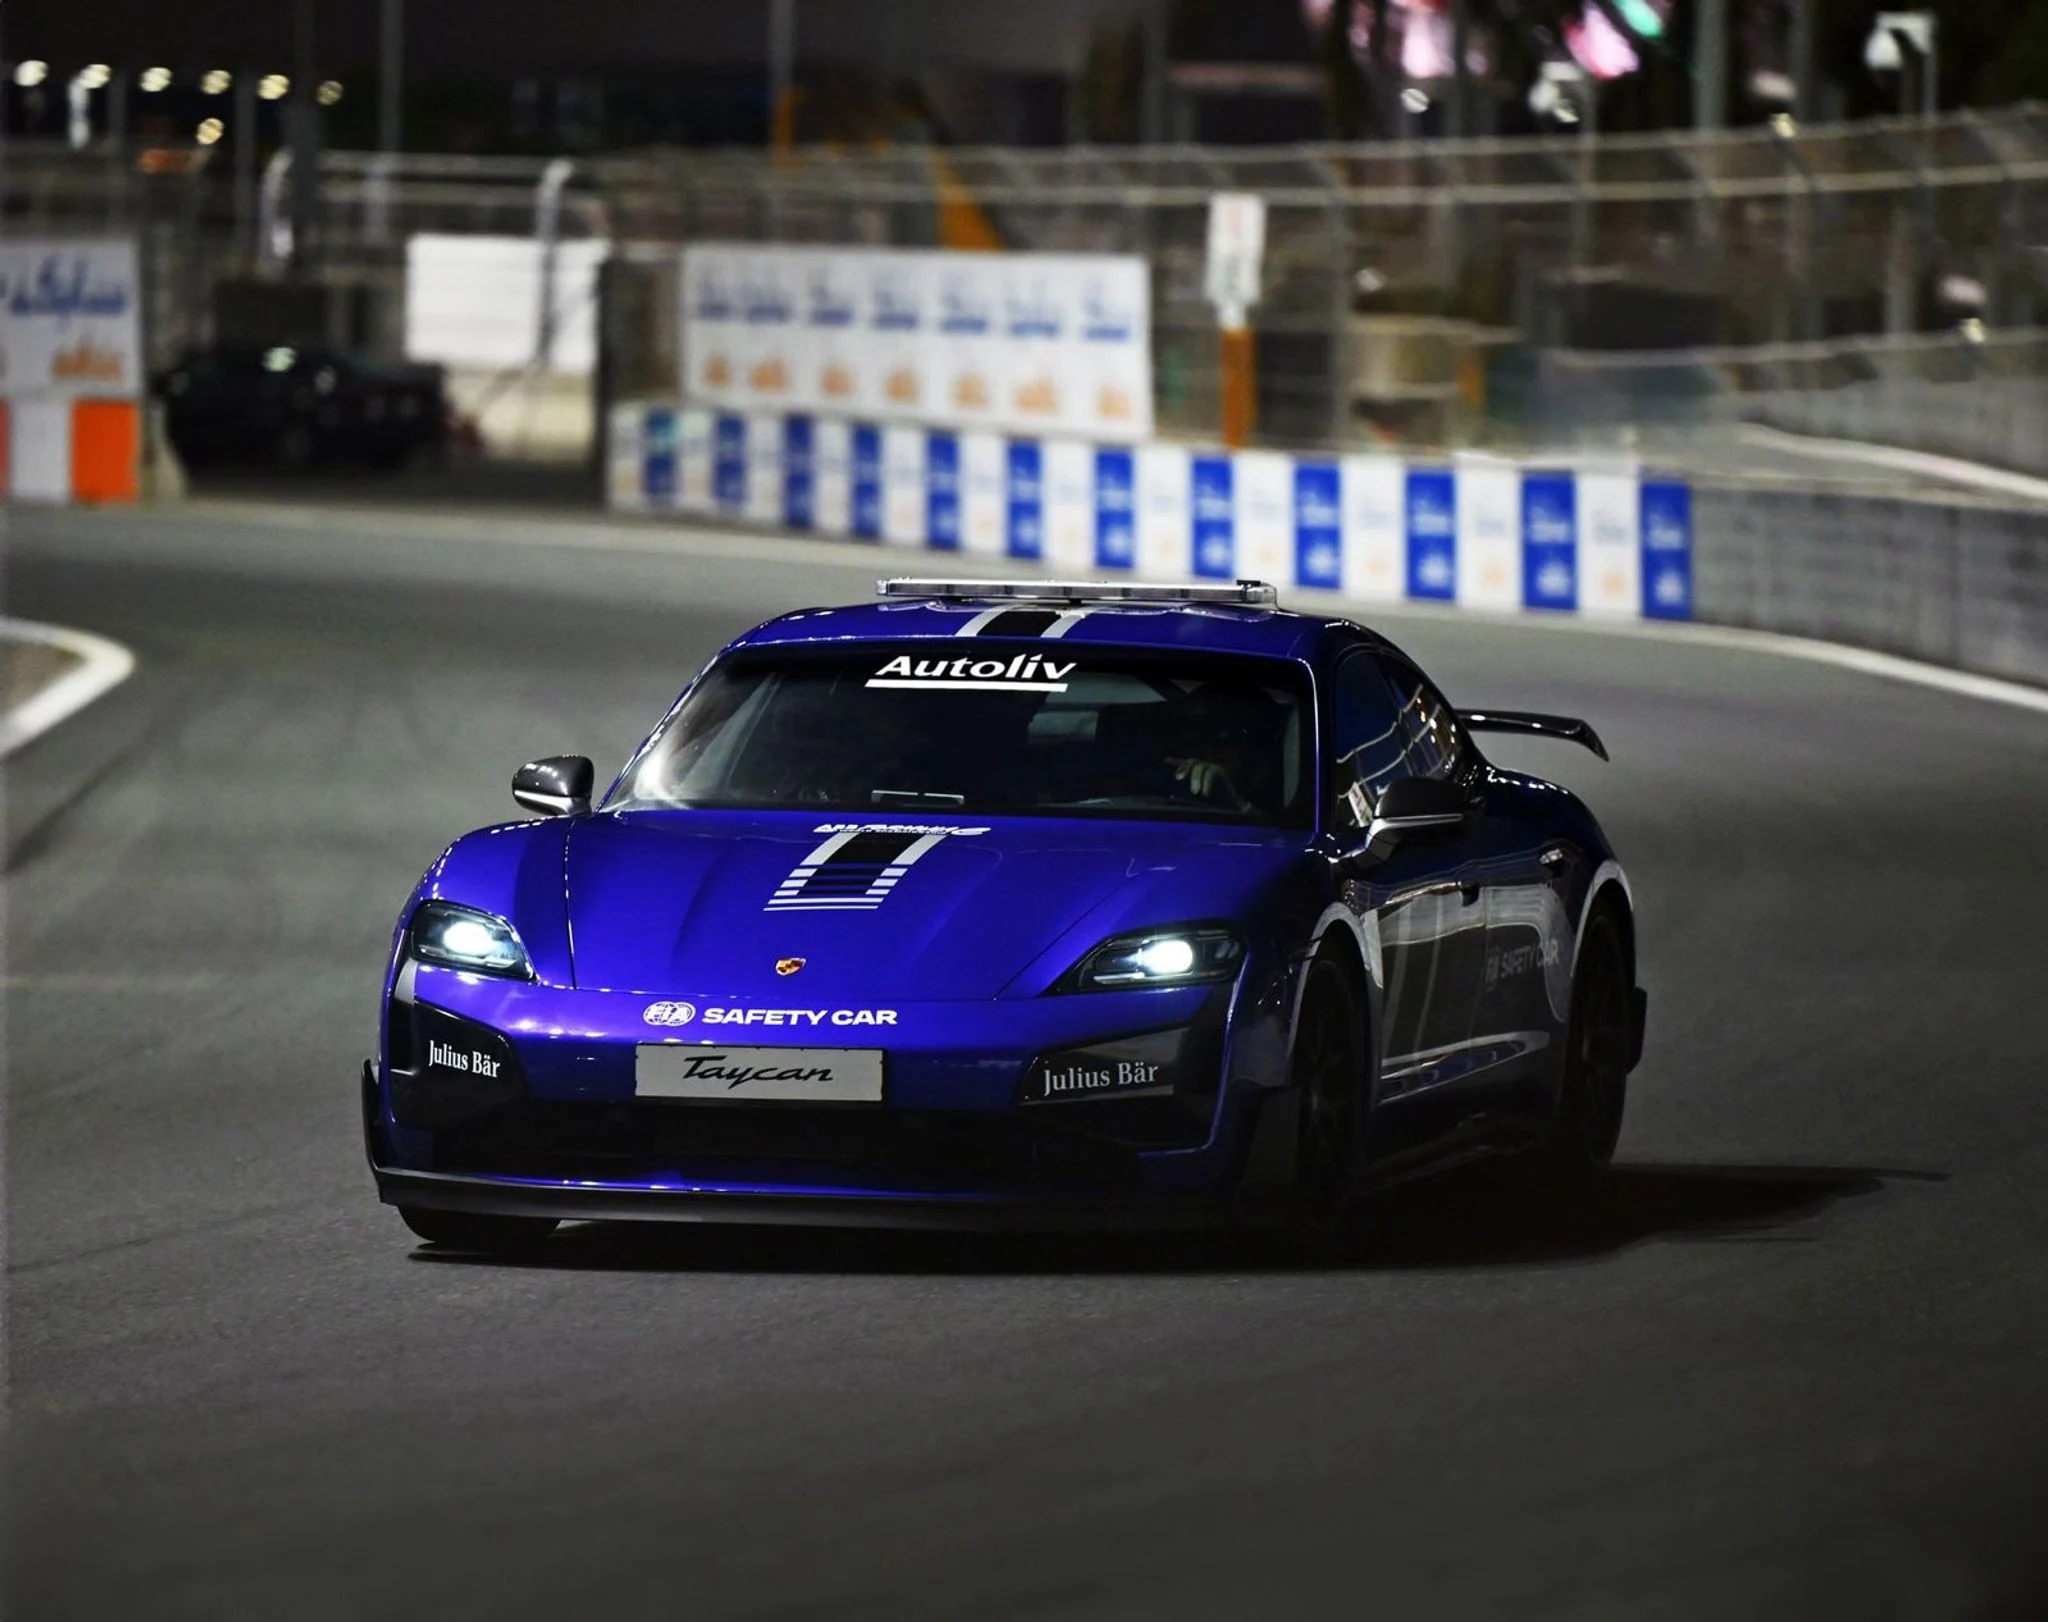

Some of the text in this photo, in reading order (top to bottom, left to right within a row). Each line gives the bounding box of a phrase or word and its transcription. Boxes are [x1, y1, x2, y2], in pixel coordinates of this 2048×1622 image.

[875, 653, 1077, 680] Autoliv
[703, 1008, 828, 1025] SAFETY
[831, 1010, 898, 1025] CAR
[428, 1039, 501, 1078] Julius Bär
[683, 1055, 834, 1090] Taycan
[1044, 1061, 1159, 1097] Julius Bär
